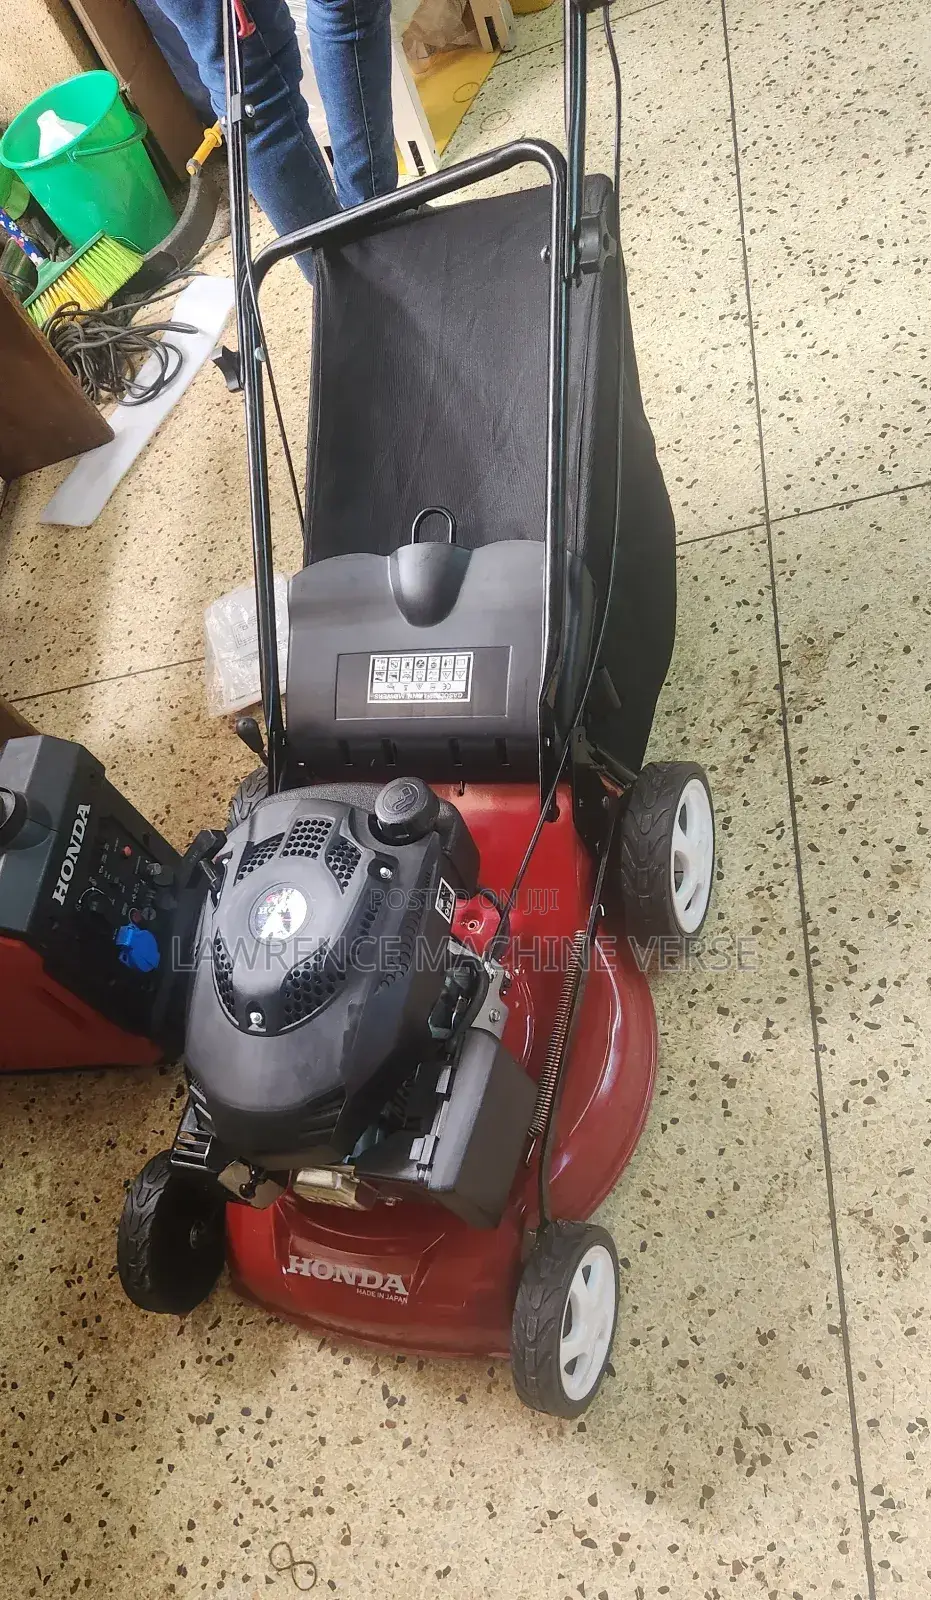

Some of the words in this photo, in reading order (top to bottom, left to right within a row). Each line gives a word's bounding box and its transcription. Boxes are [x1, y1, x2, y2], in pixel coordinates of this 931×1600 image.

[52, 803, 91, 906] HONDA
[287, 1255, 409, 1295] HONDA
[356, 1288, 376, 1298] MADE
[377, 1292, 385, 1300] IN
[385, 1293, 409, 1304] JAPAN
